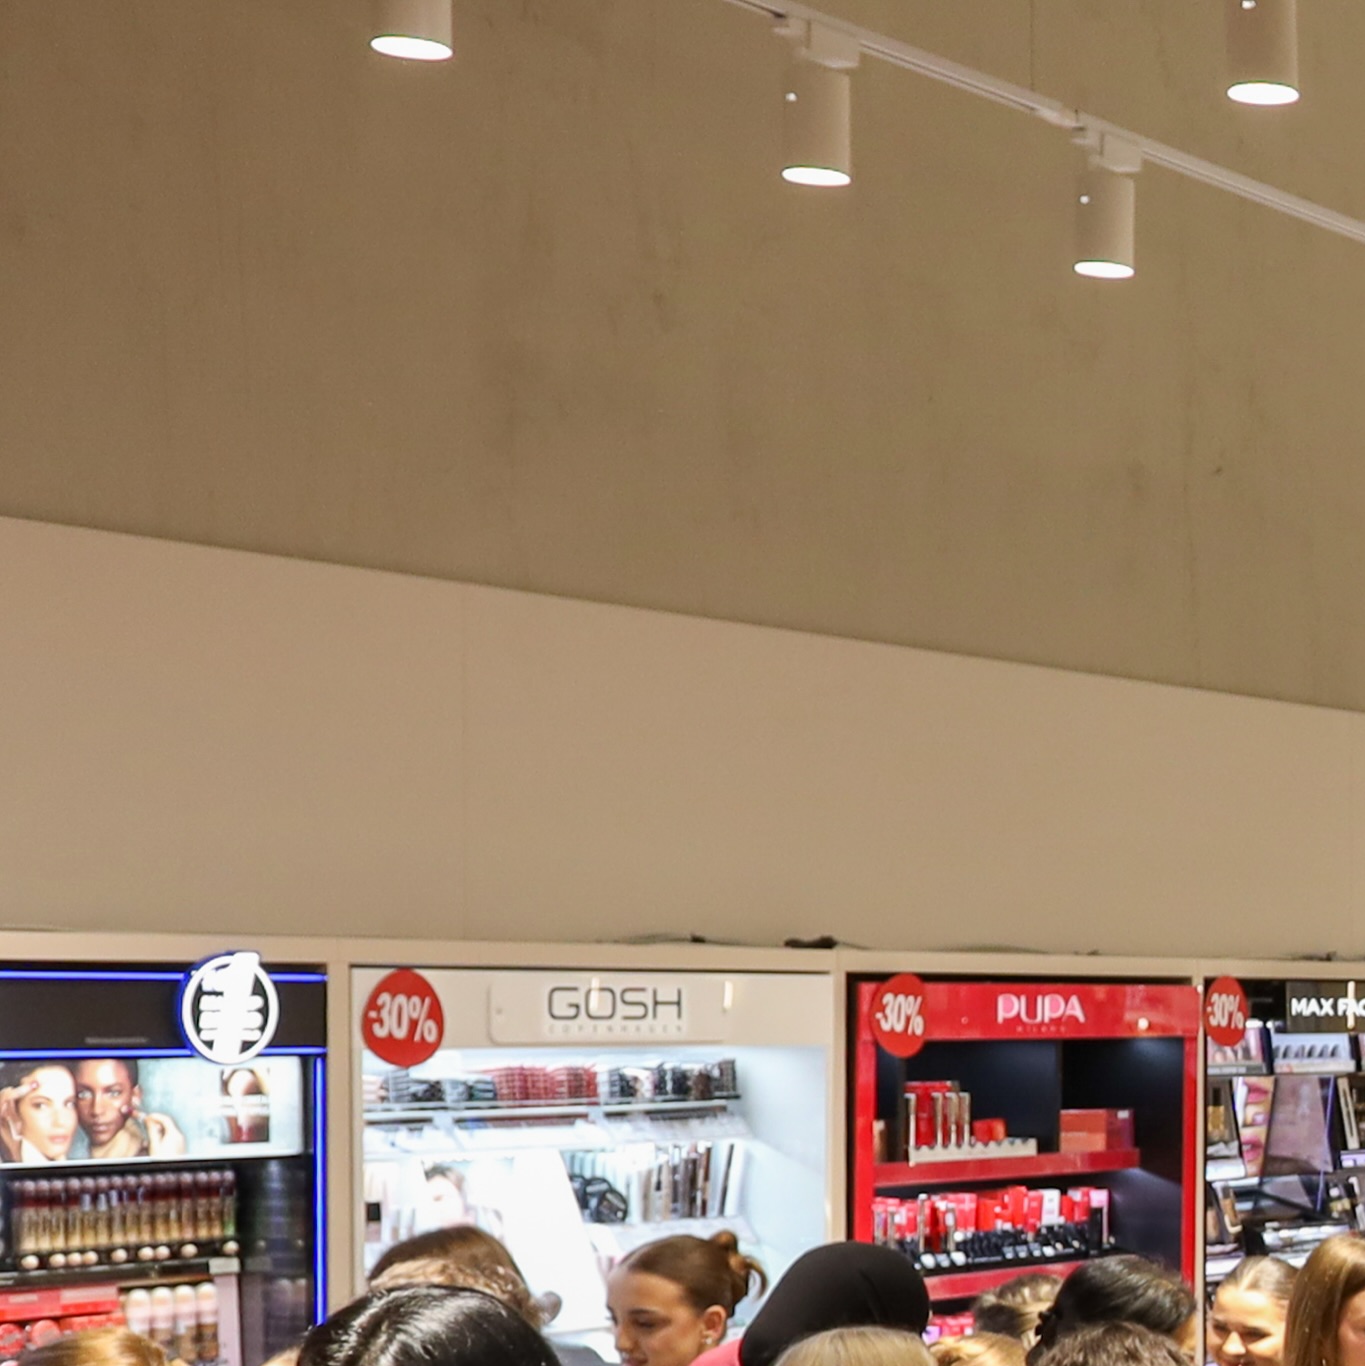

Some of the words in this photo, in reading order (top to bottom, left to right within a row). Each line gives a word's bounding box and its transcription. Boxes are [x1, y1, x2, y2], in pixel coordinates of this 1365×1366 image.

[367, 991, 438, 1043] -30%
[547, 986, 682, 1020] GOSH
[875, 992, 924, 1036] -30%
[997, 993, 1086, 1024] PUPA
[1206, 993, 1244, 1030] -30%
[1291, 997, 1334, 1017] MAX
